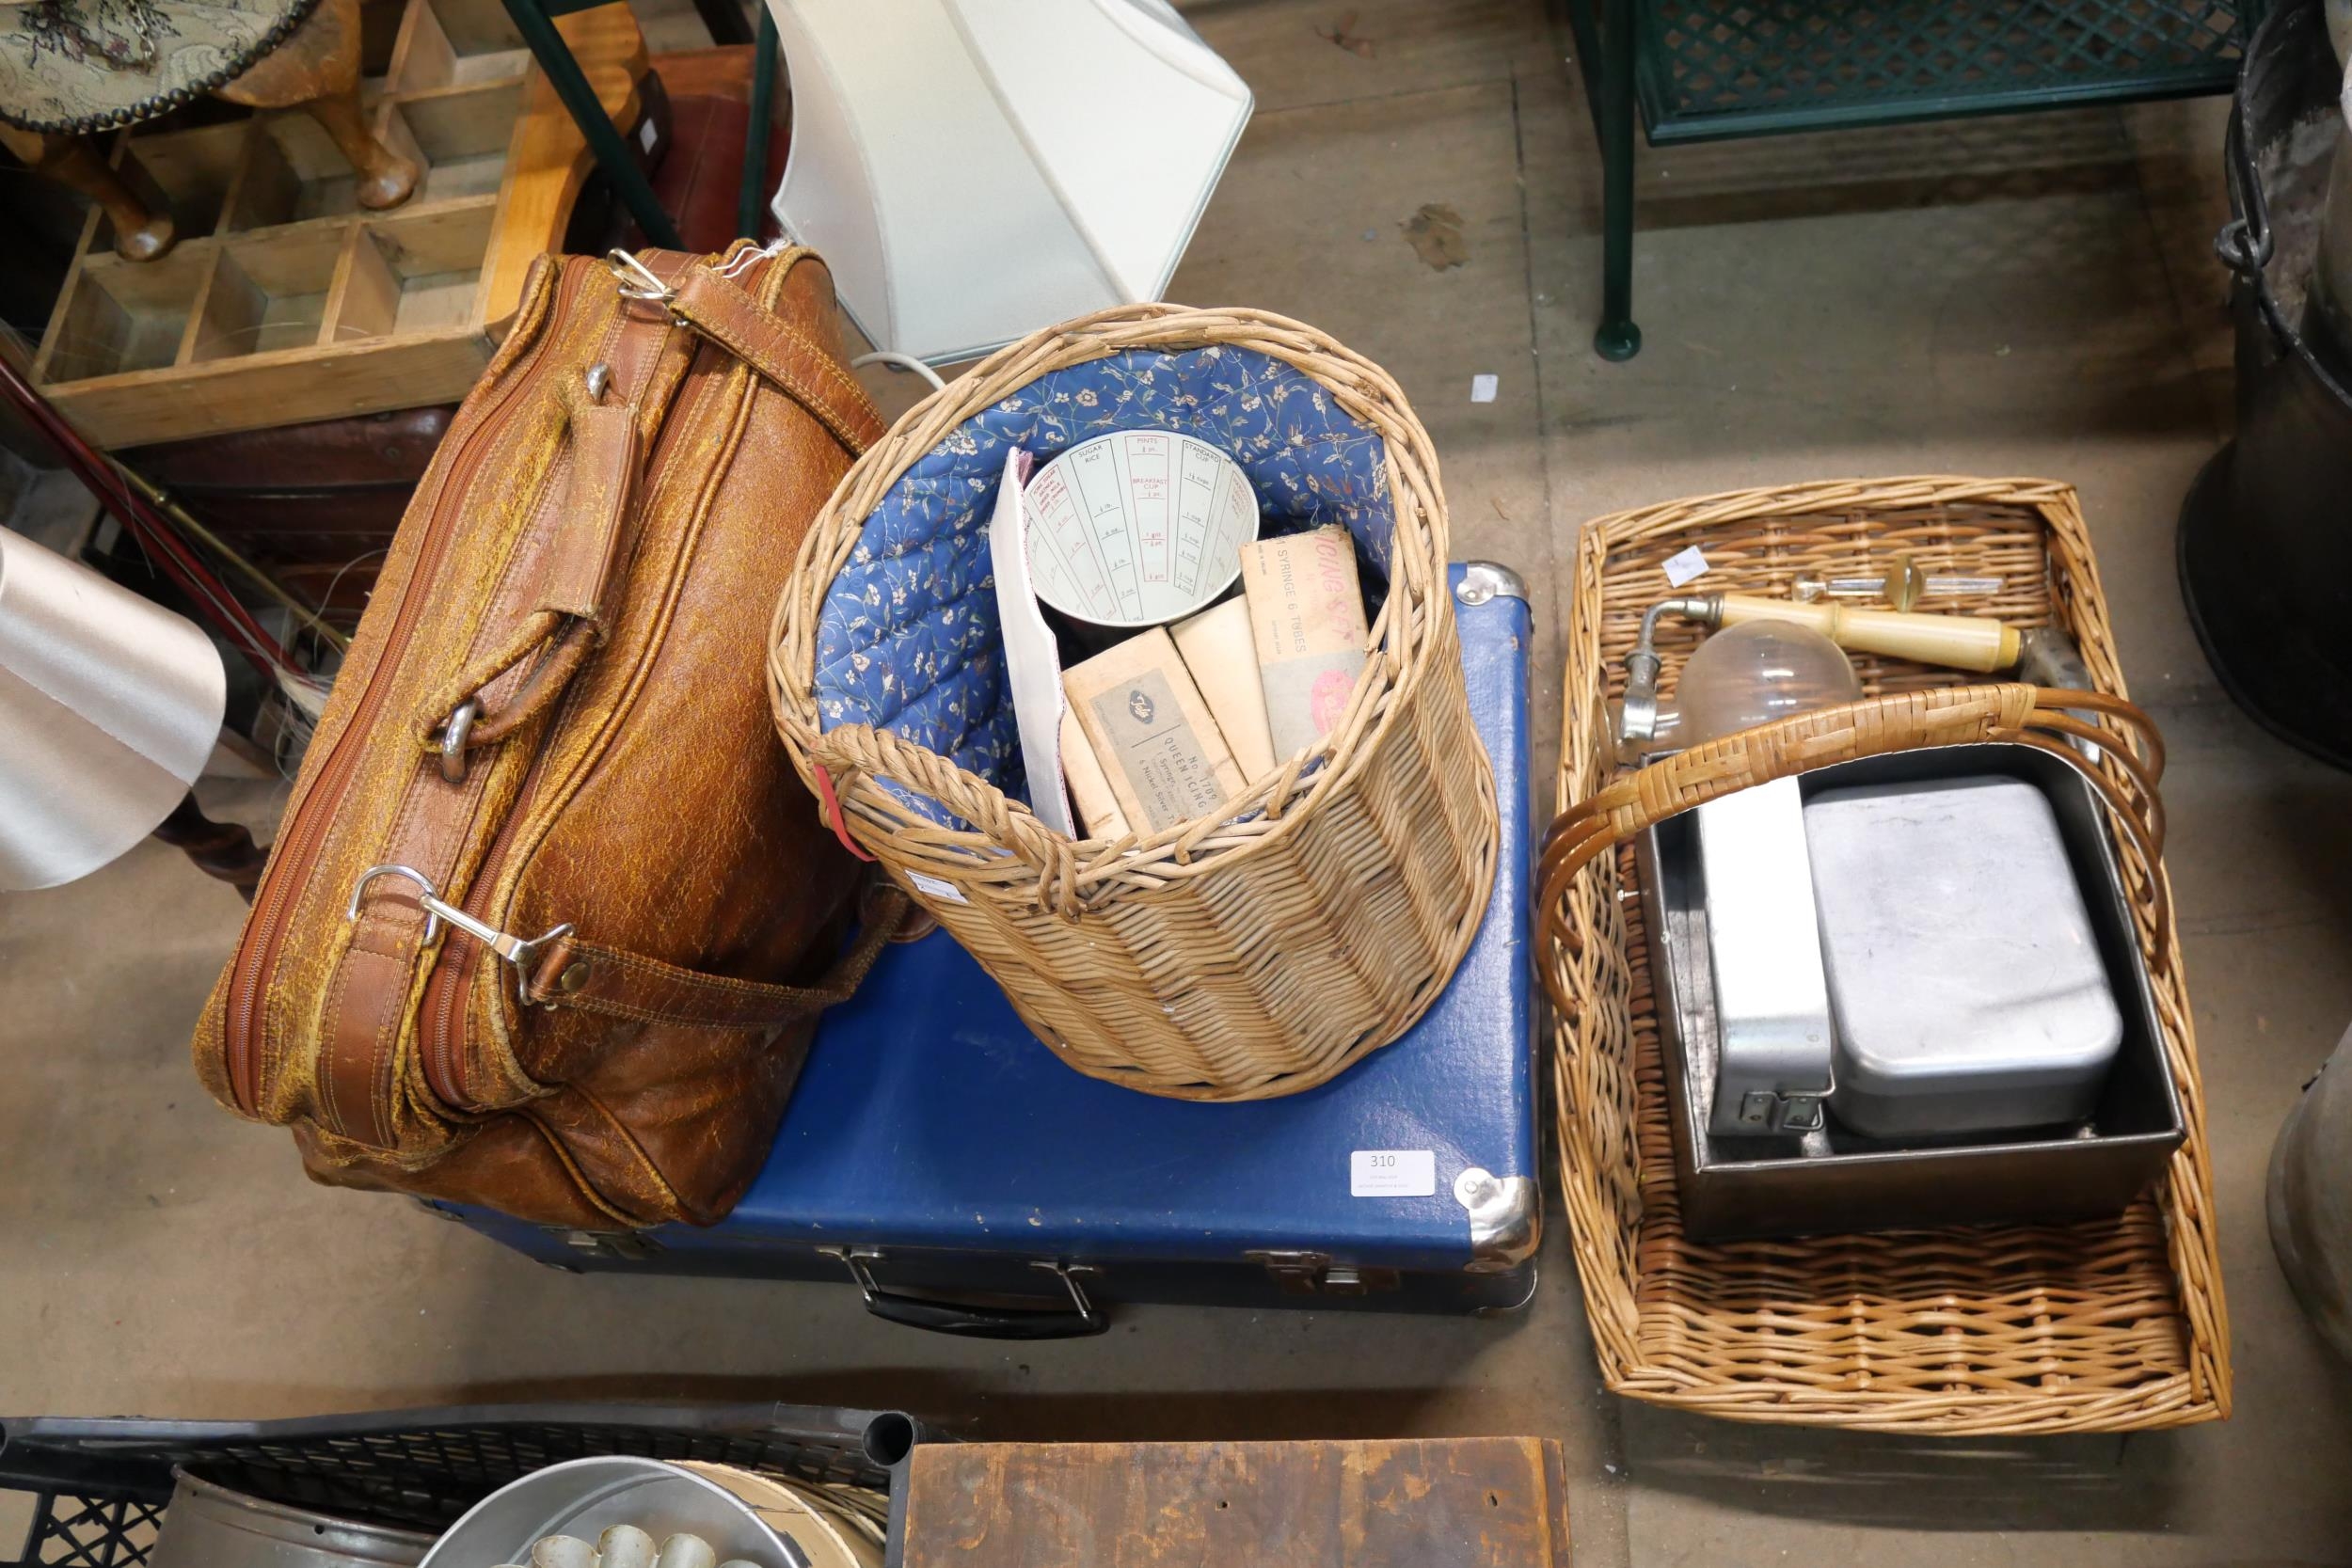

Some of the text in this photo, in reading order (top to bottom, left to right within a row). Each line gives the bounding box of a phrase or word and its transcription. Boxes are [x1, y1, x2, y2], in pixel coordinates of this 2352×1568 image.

[1078, 445, 1103, 458] SUGAR
[1085, 453, 1100, 463] RICE
[1185, 443, 1219, 463] STANDARD
[1314, 535, 1345, 593] ICING
[1278, 550, 1296, 598] SYRINGE
[1291, 615, 1307, 653] TUBES
[1165, 737, 1189, 773] QUEEN
[1185, 776, 1207, 808] ICING
[1143, 767, 1158, 790] Nickel
[1155, 791, 1168, 811] Silver
[1200, 777, 1217, 800] 1709
[1370, 1155, 1395, 1167] 310
